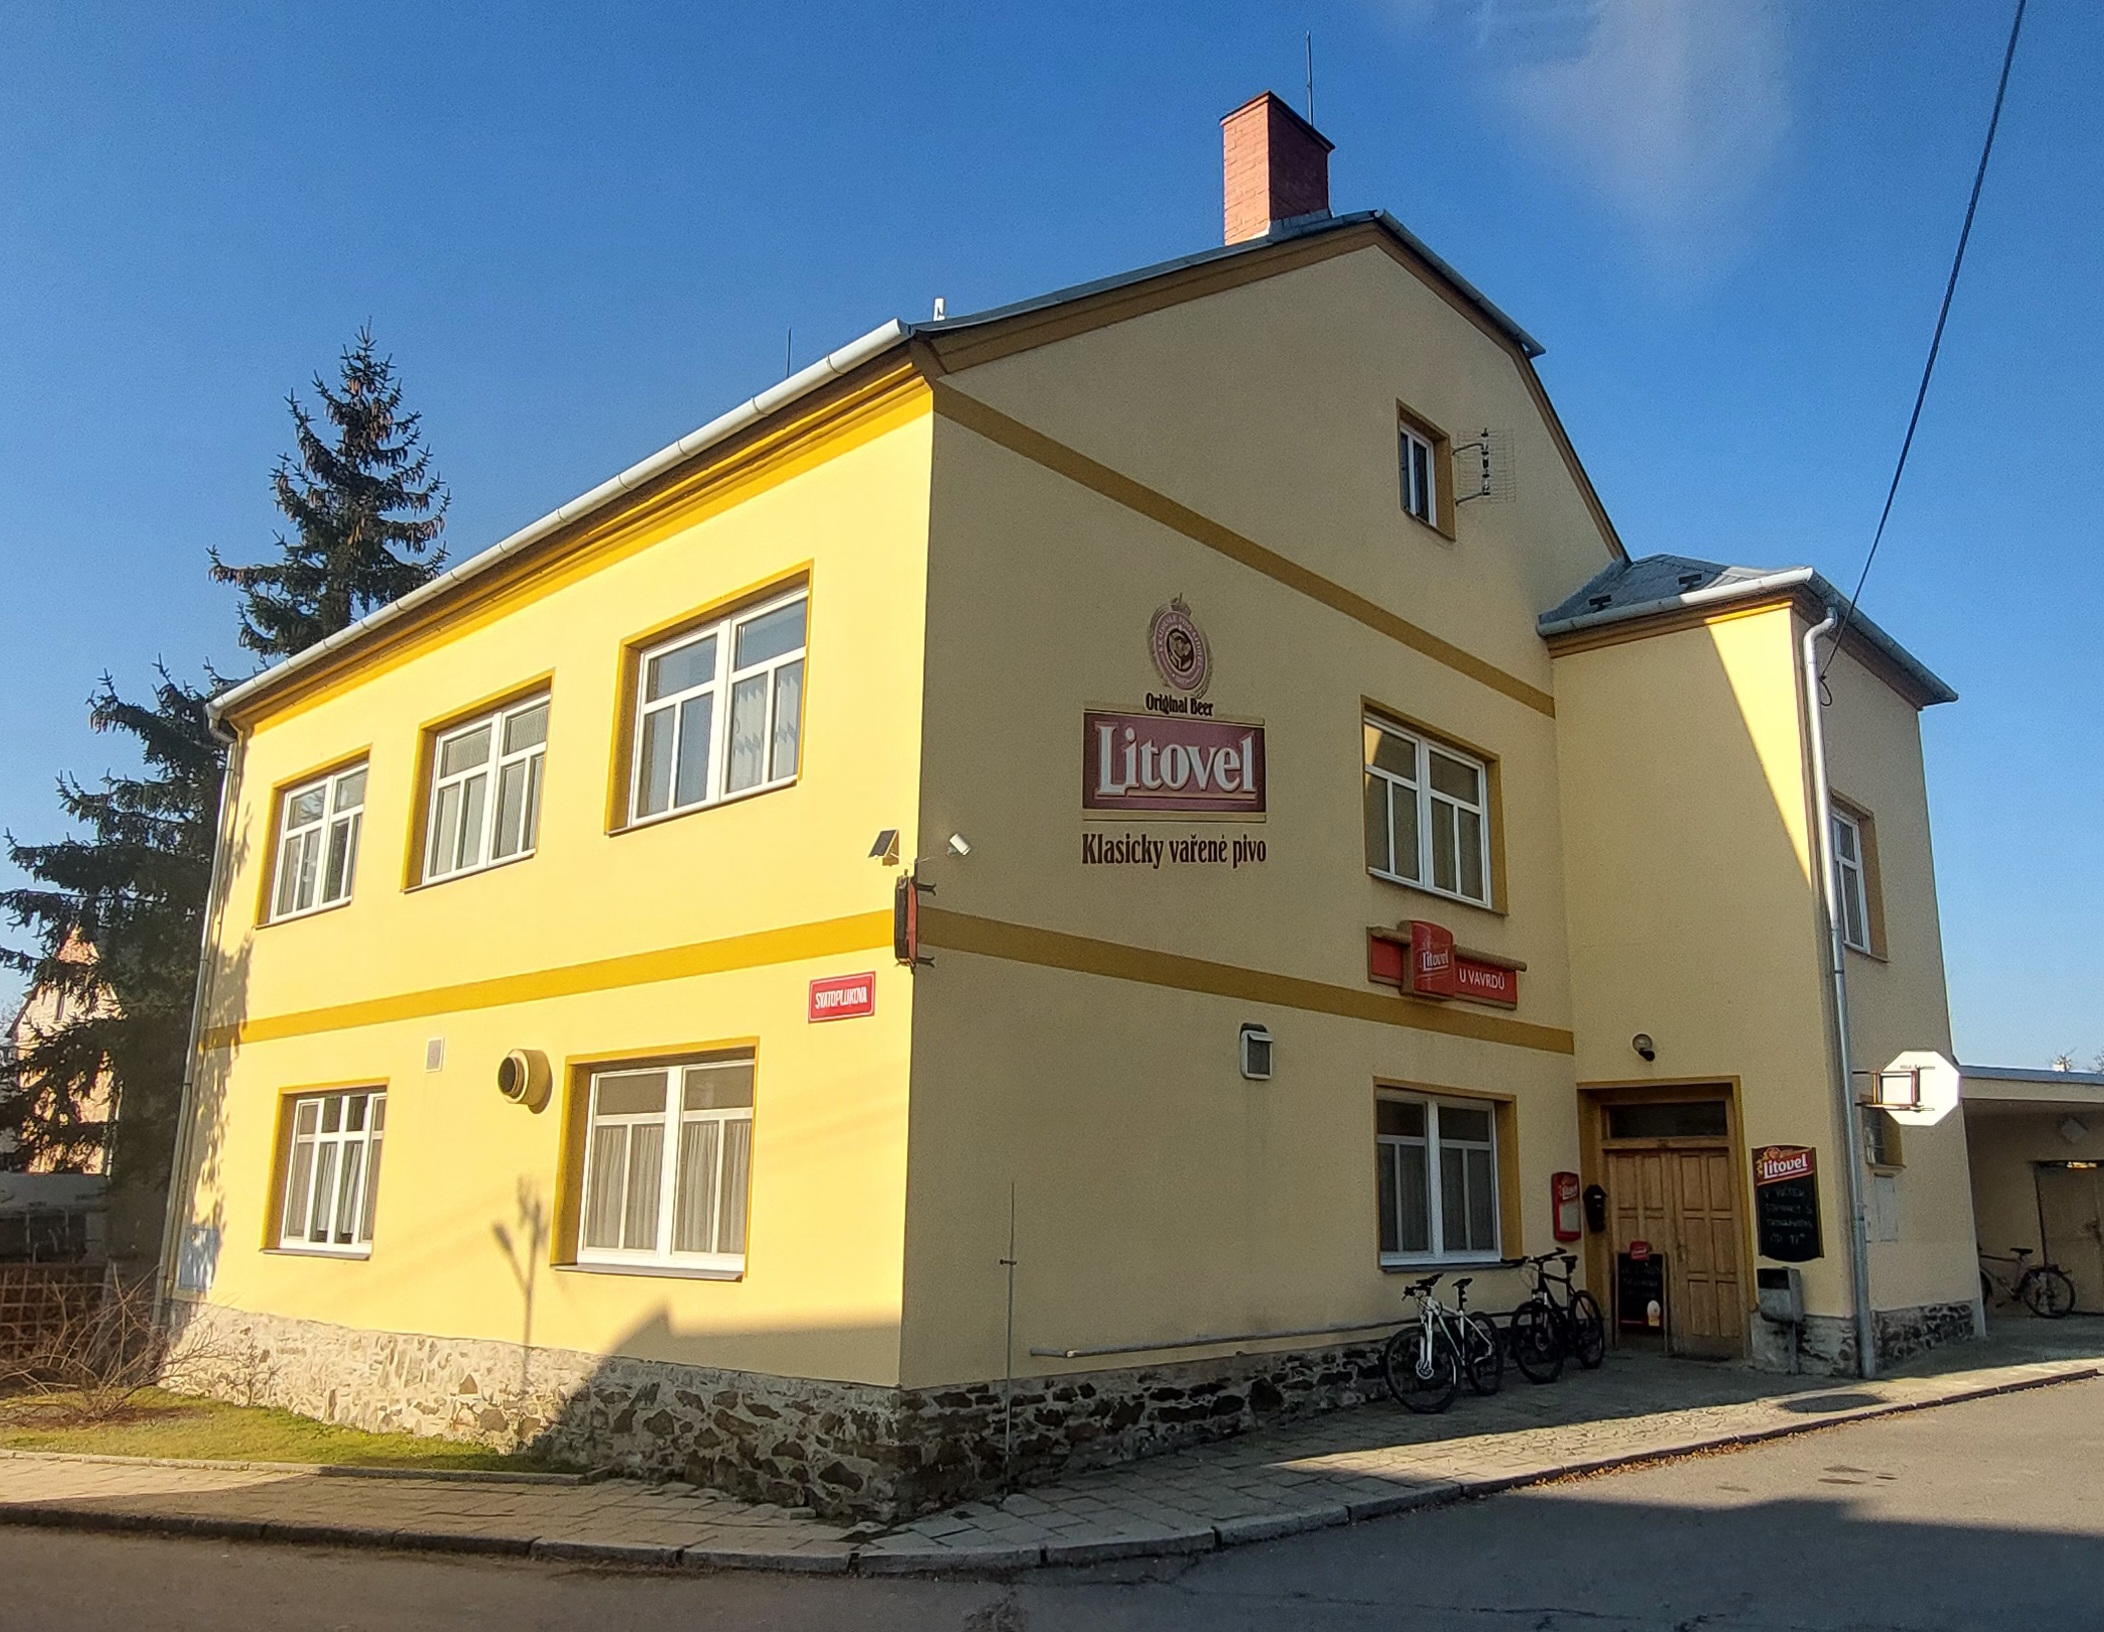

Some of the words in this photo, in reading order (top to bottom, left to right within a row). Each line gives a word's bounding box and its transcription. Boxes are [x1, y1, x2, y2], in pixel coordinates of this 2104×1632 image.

[1145, 692, 1188, 715] Original
[1190, 697, 1214, 717] Beer
[1094, 721, 1257, 799] Litovel
[1082, 833, 1164, 869] Klasicky
[1169, 834, 1228, 864] vařené
[1232, 834, 1267, 869] pivo
[1422, 949, 1450, 972] Litovel
[1459, 967, 1467, 983] U
[815, 986, 868, 1010] SVATOPLUKOVA
[1763, 1153, 1808, 1179] Litovel
